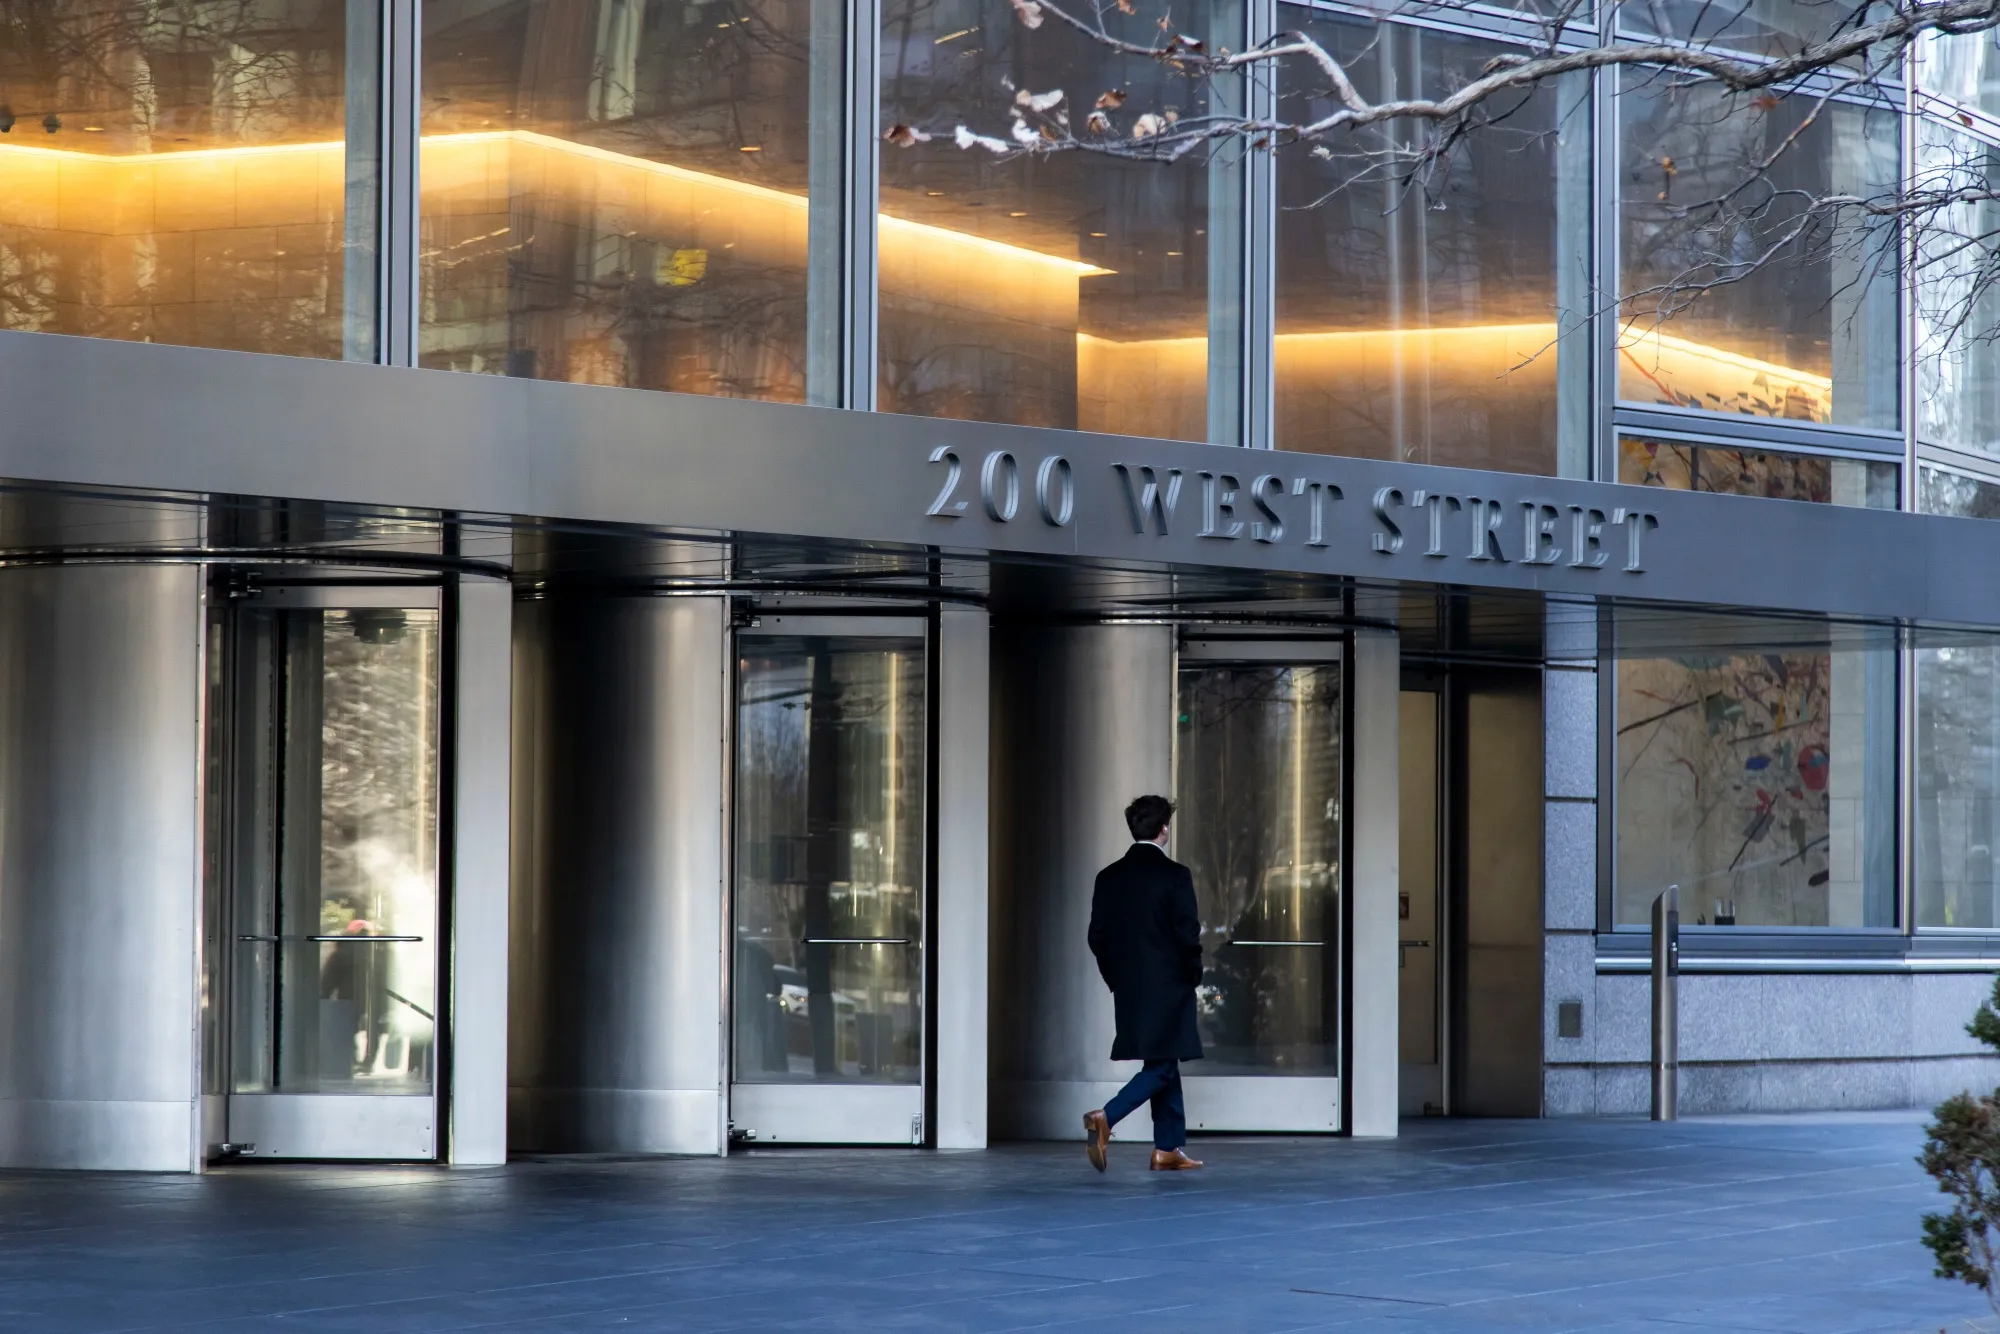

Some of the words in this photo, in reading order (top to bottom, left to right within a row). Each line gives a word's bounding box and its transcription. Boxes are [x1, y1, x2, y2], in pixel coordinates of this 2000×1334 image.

[925, 445, 1074, 527] 200
[1110, 462, 1344, 547] WEST
[1372, 486, 1659, 573] STREET
